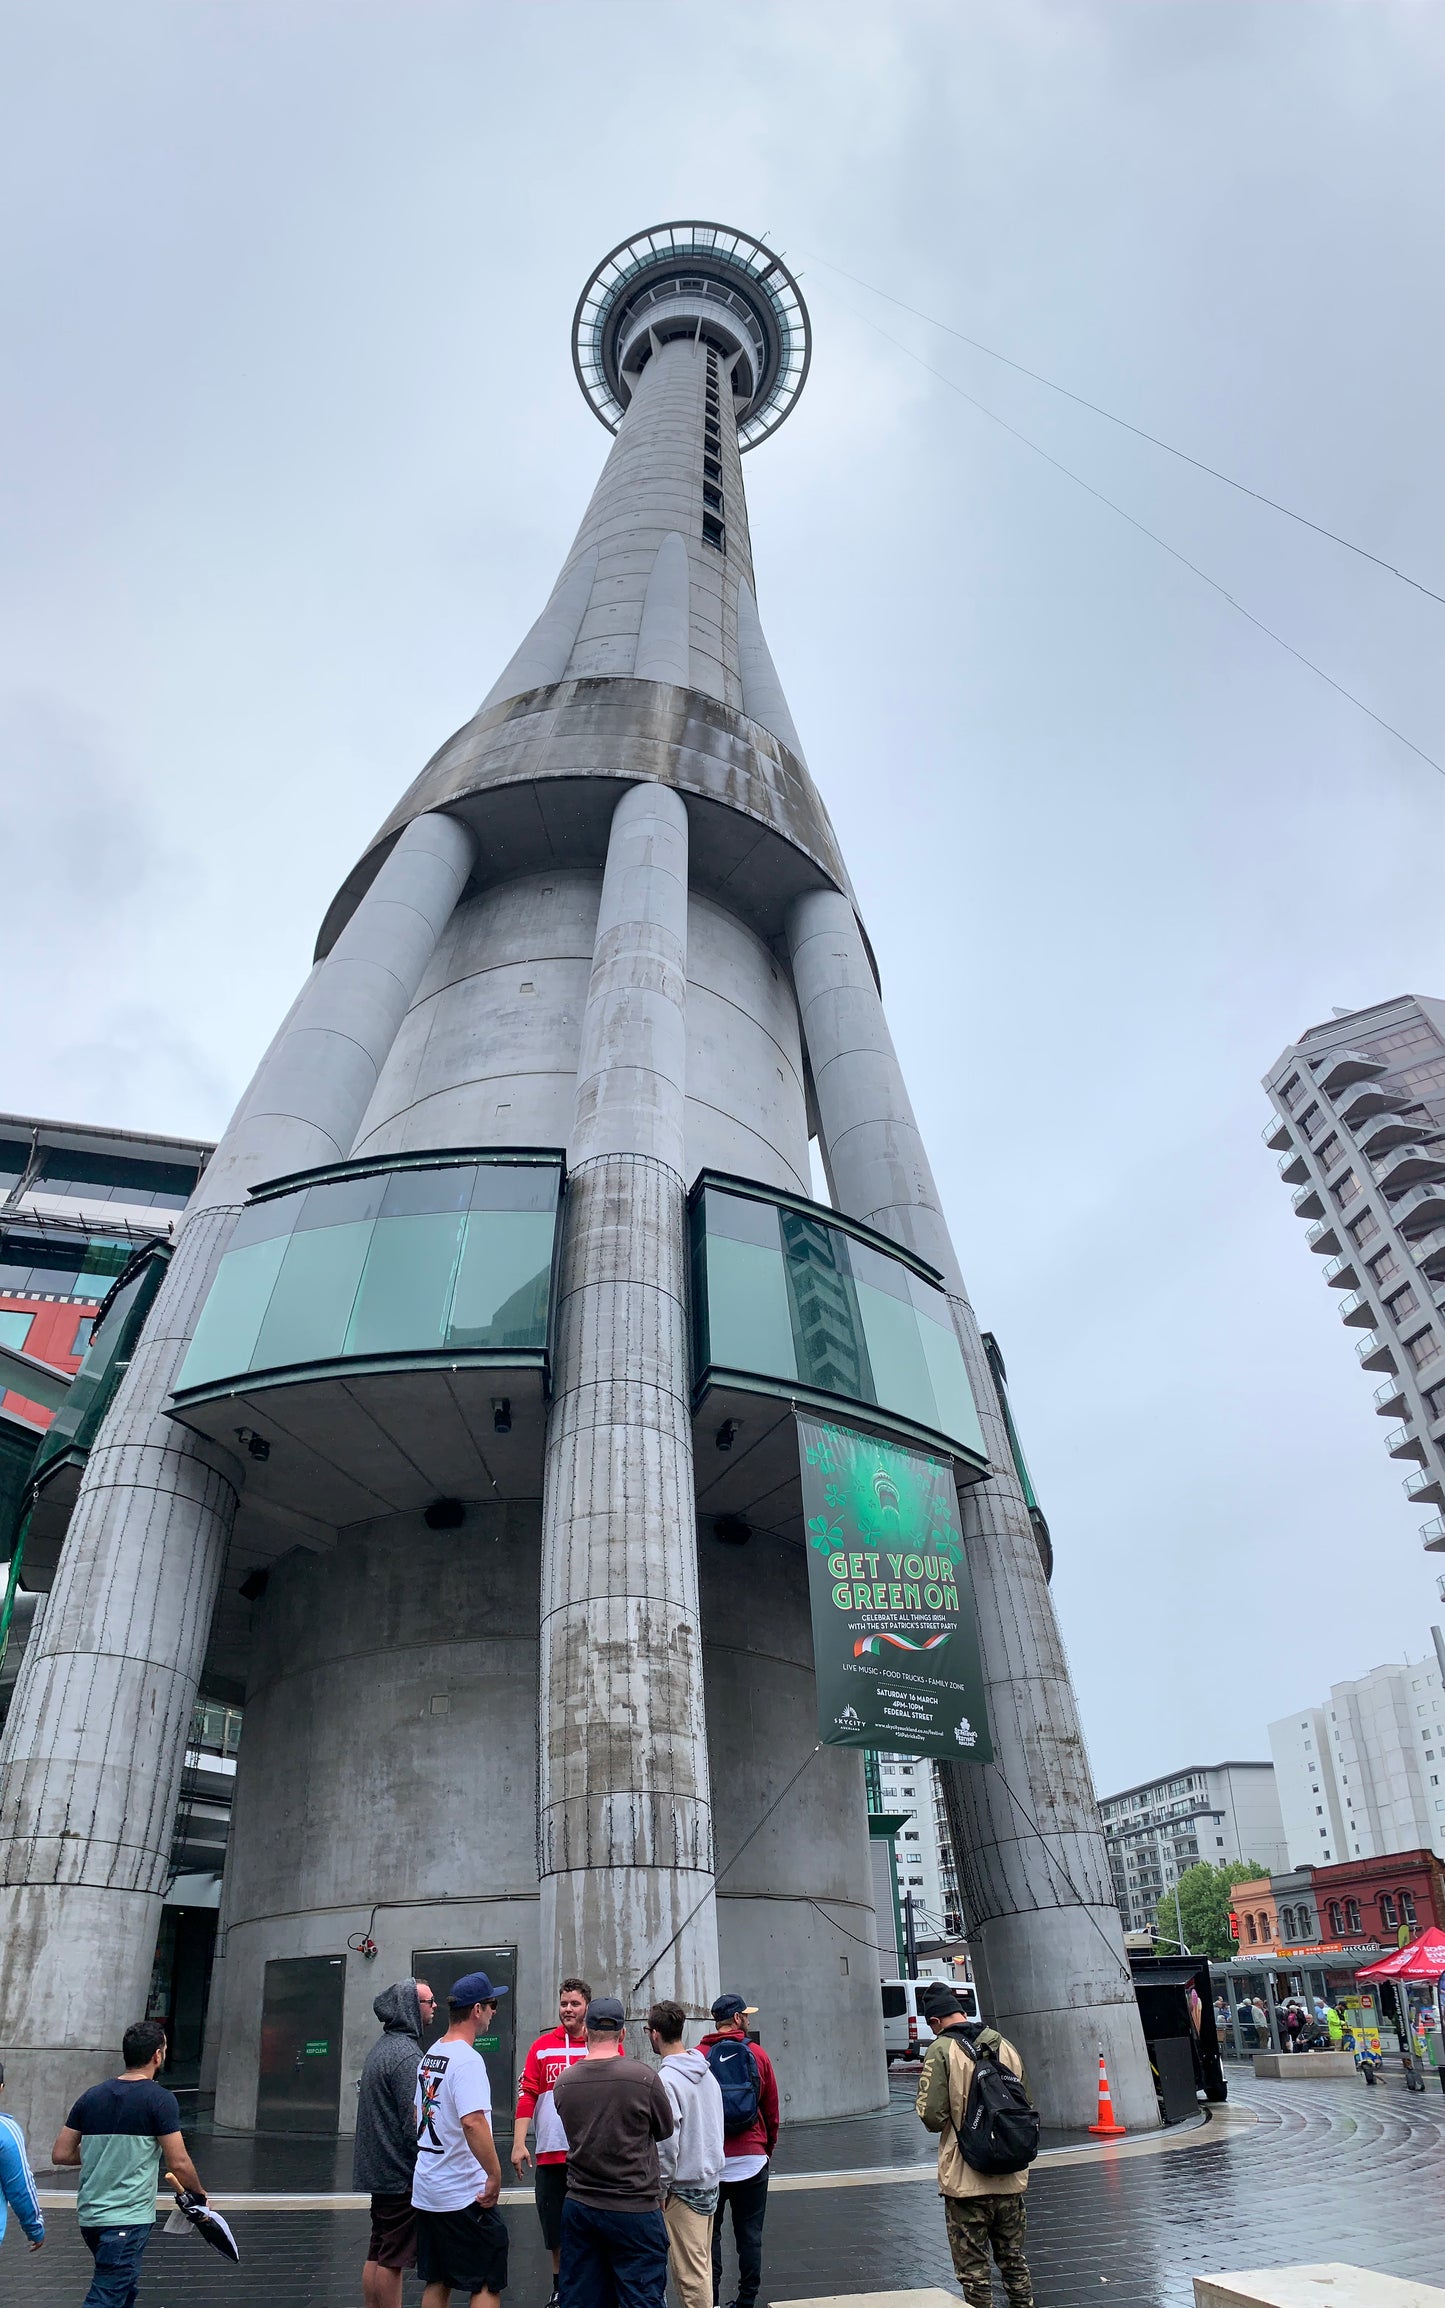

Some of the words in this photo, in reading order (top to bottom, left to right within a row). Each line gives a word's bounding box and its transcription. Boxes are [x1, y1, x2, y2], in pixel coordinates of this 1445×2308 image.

[828, 1552, 880, 1580] GET
[887, 1552, 955, 1583] YOUR
[831, 1582, 922, 1611] GREEN
[924, 1583, 960, 1611] ON
[861, 1613, 898, 1622] CELEBRATE
[899, 1613, 909, 1621] ALL
[848, 1622, 866, 1630] WITH
[867, 1622, 880, 1630] THE
[880, 1621, 888, 1629] ST
[889, 1621, 919, 1629] PATRICK'S
[940, 1622, 958, 1630] PARTY
[842, 1663, 857, 1672] LIVE
[858, 1666, 879, 1676] MUSIC
[882, 1669, 901, 1679] FOOD
[901, 1672, 924, 1684] TRUCKS
[928, 1677, 948, 1688] FAMILY
[949, 1681, 965, 1692] ZONE
[876, 1688, 907, 1700] SATURDAY
[908, 1693, 916, 1701] 16
[916, 1695, 939, 1705] MARCH
[892, 1700, 924, 1711] 4PM-10PM
[883, 1707, 911, 1718] FEDERAL
[911, 1712, 933, 1721] STREET
[834, 1718, 866, 1727] SKYCITY
[422, 2056, 447, 2070] ABSENT
